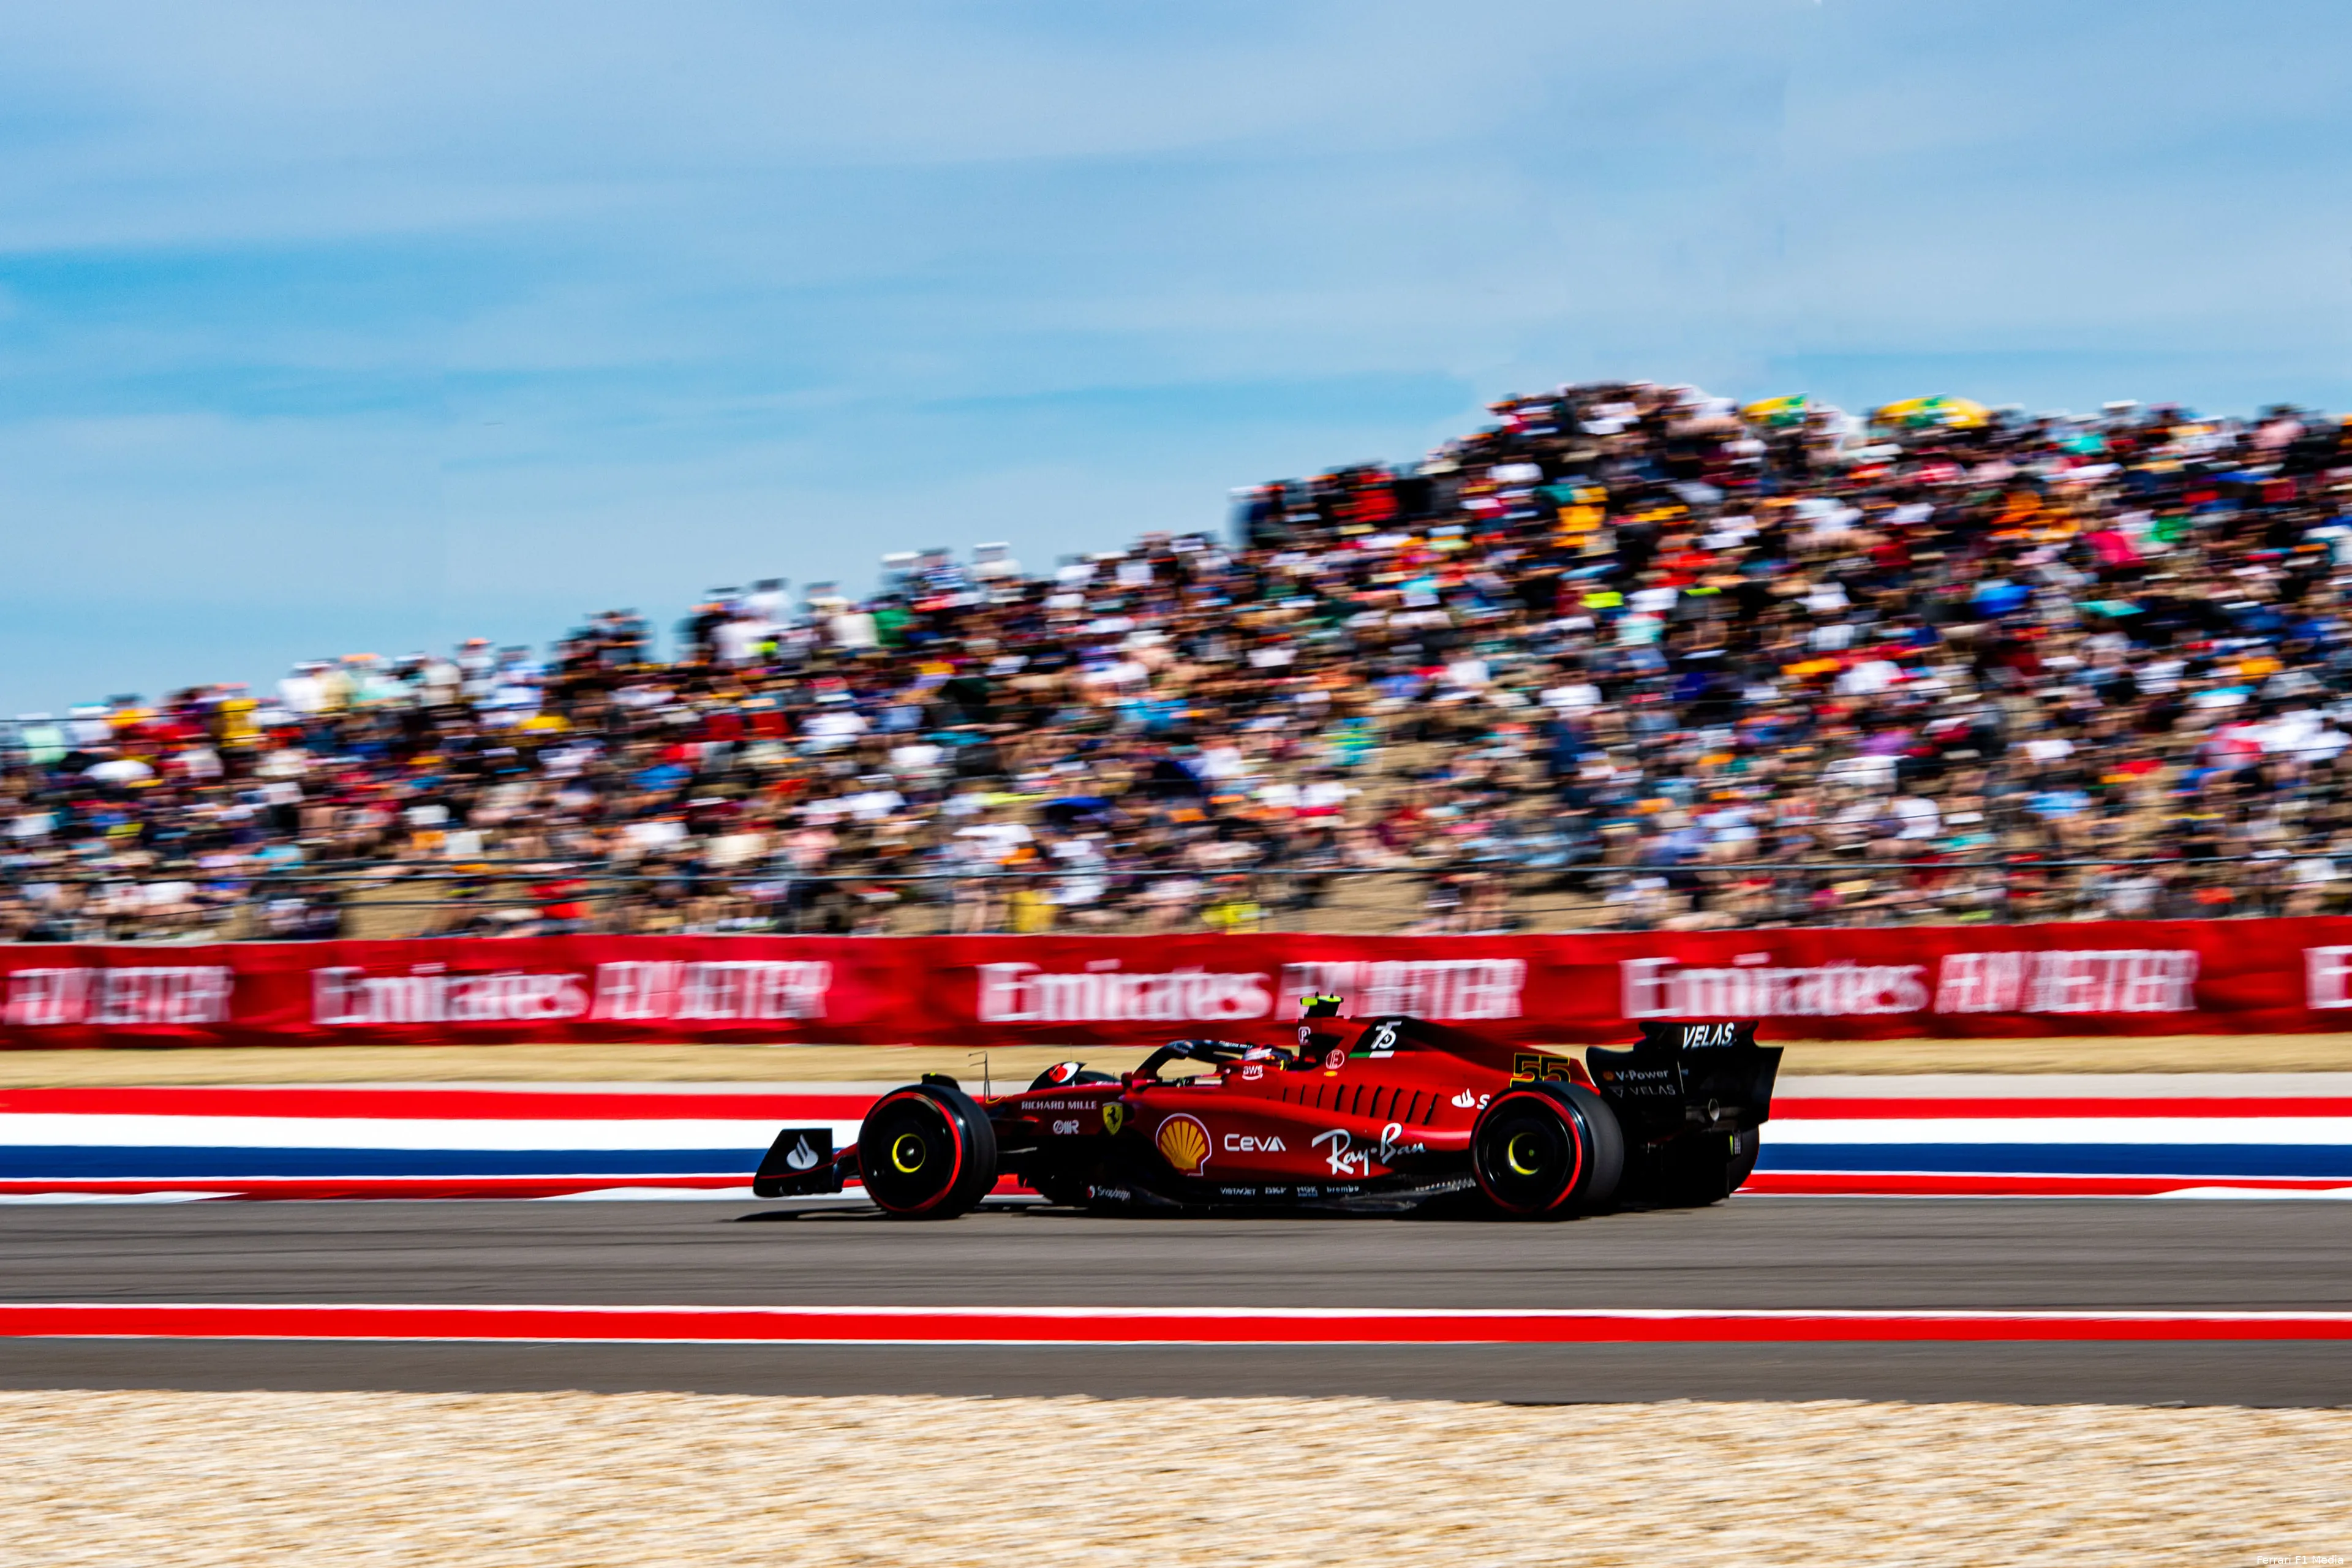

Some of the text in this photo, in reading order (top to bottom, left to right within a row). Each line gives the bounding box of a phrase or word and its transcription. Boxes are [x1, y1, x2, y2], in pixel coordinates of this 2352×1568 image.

[311, 962, 589, 1025] Emirates
[978, 959, 1273, 1021] Emirates
[1619, 952, 1928, 1017] Emirates
[1682, 1022, 1735, 1049] VELAS
[1243, 1065, 1263, 1077] aws
[1509, 1052, 1571, 1088] 55
[1629, 1084, 1676, 1096] VELAS
[1021, 1101, 1097, 1110] RICHARD MILLE
[1327, 1185, 1359, 1193] brembo
